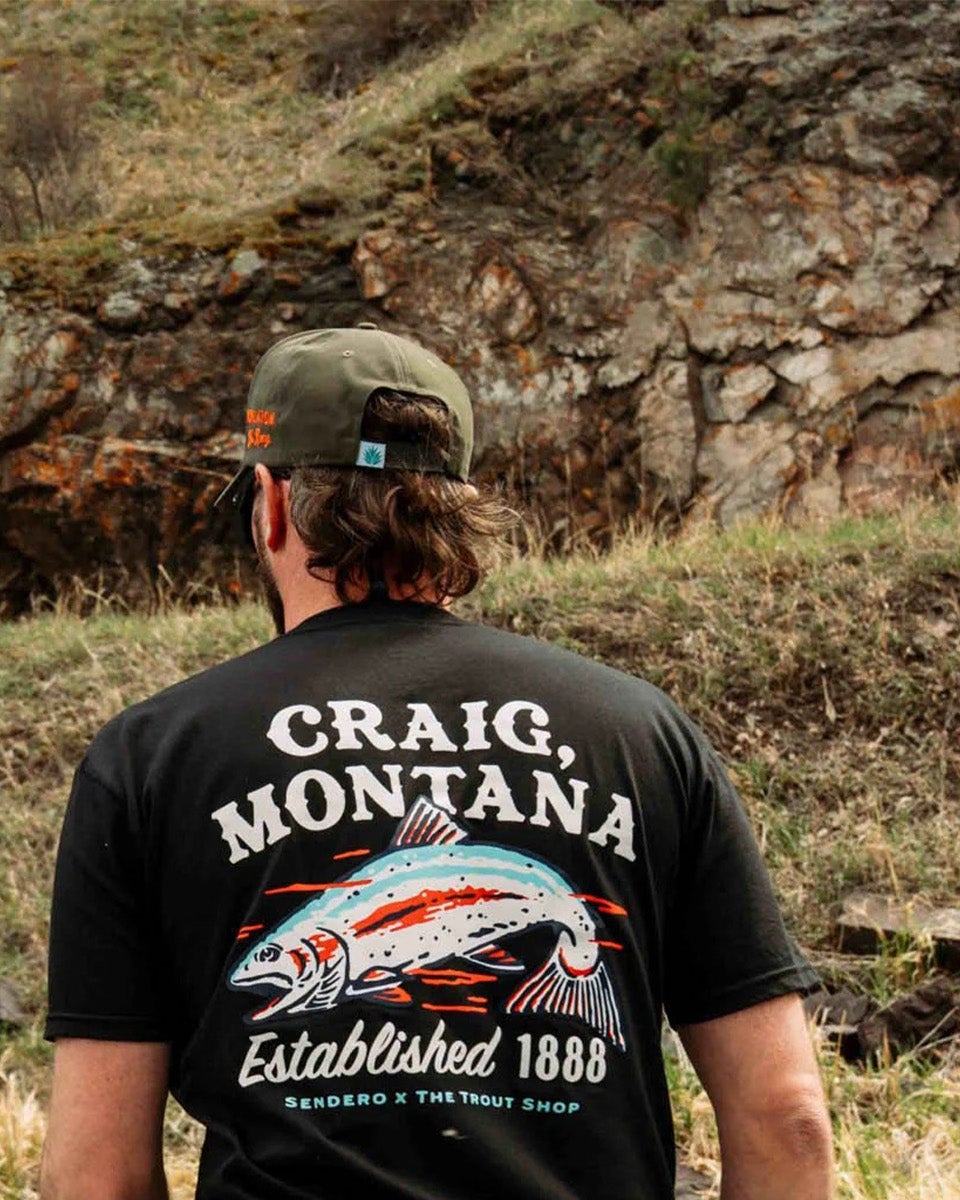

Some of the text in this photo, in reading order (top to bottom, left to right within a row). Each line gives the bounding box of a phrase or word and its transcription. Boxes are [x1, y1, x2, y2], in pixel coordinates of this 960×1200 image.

[266, 700, 576, 769] CRAIG,
[211, 764, 637, 865] MONTANA
[238, 1019, 607, 1088] Established 1888
[284, 1093, 387, 1110] SENDERO
[415, 1090, 456, 1104] THE
[457, 1090, 515, 1109] TROUT
[521, 1097, 581, 1114] SHOP
